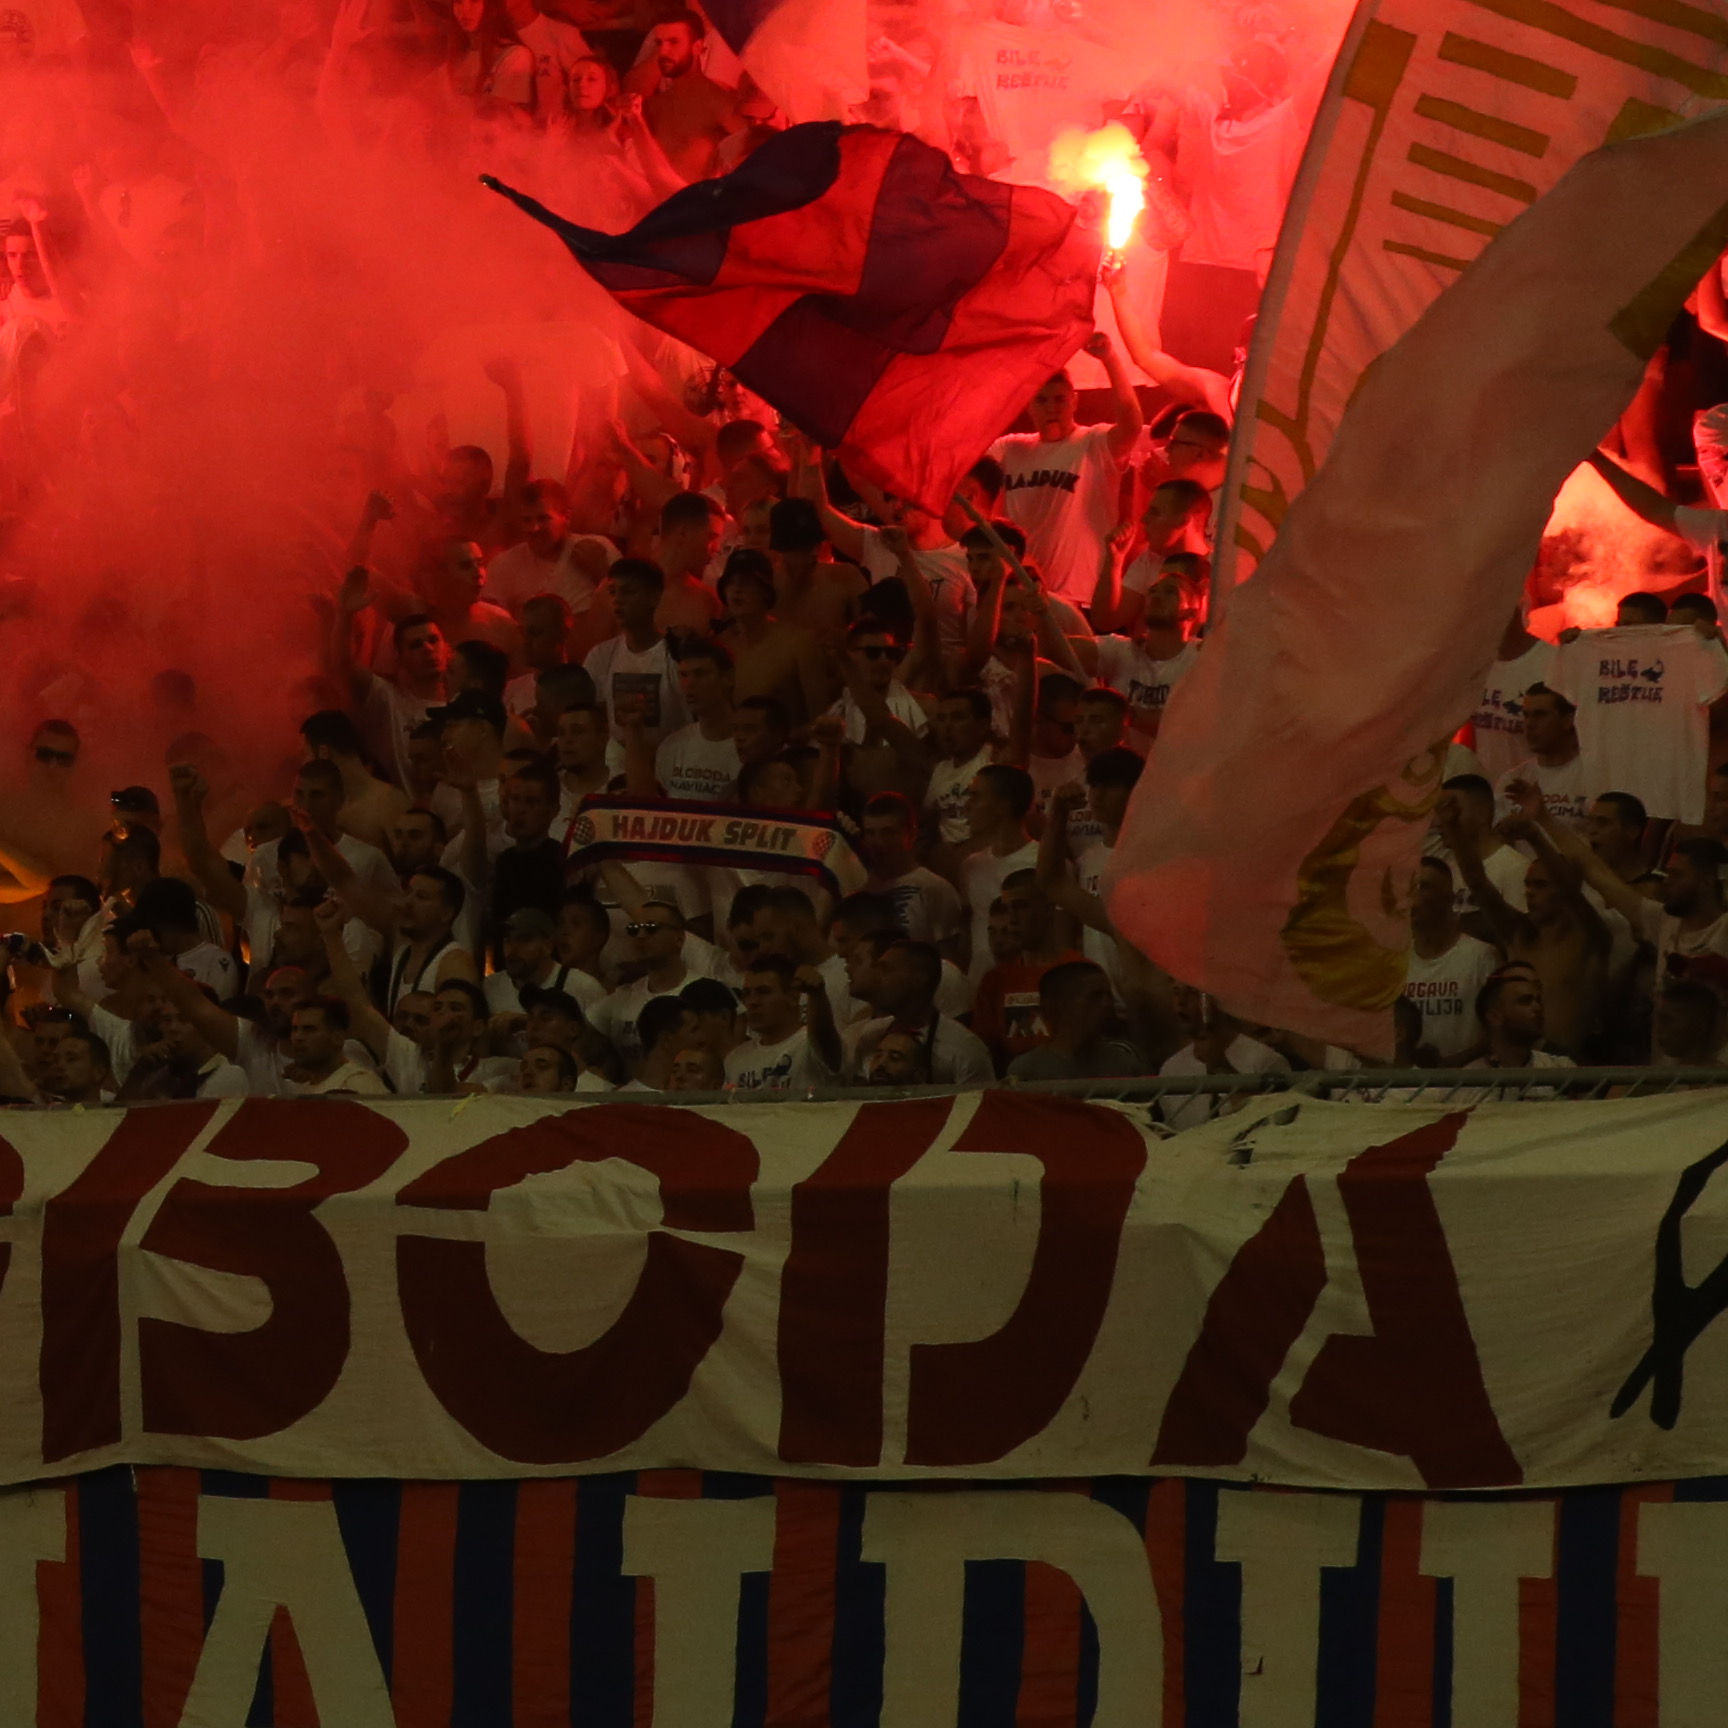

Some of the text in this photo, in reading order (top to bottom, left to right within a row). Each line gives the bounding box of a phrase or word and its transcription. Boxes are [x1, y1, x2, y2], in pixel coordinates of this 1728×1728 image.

[996, 50, 1041, 66] BILE
[1598, 658, 1638, 679] BILE
[612, 814, 797, 851] HAJDUK SPLIT
